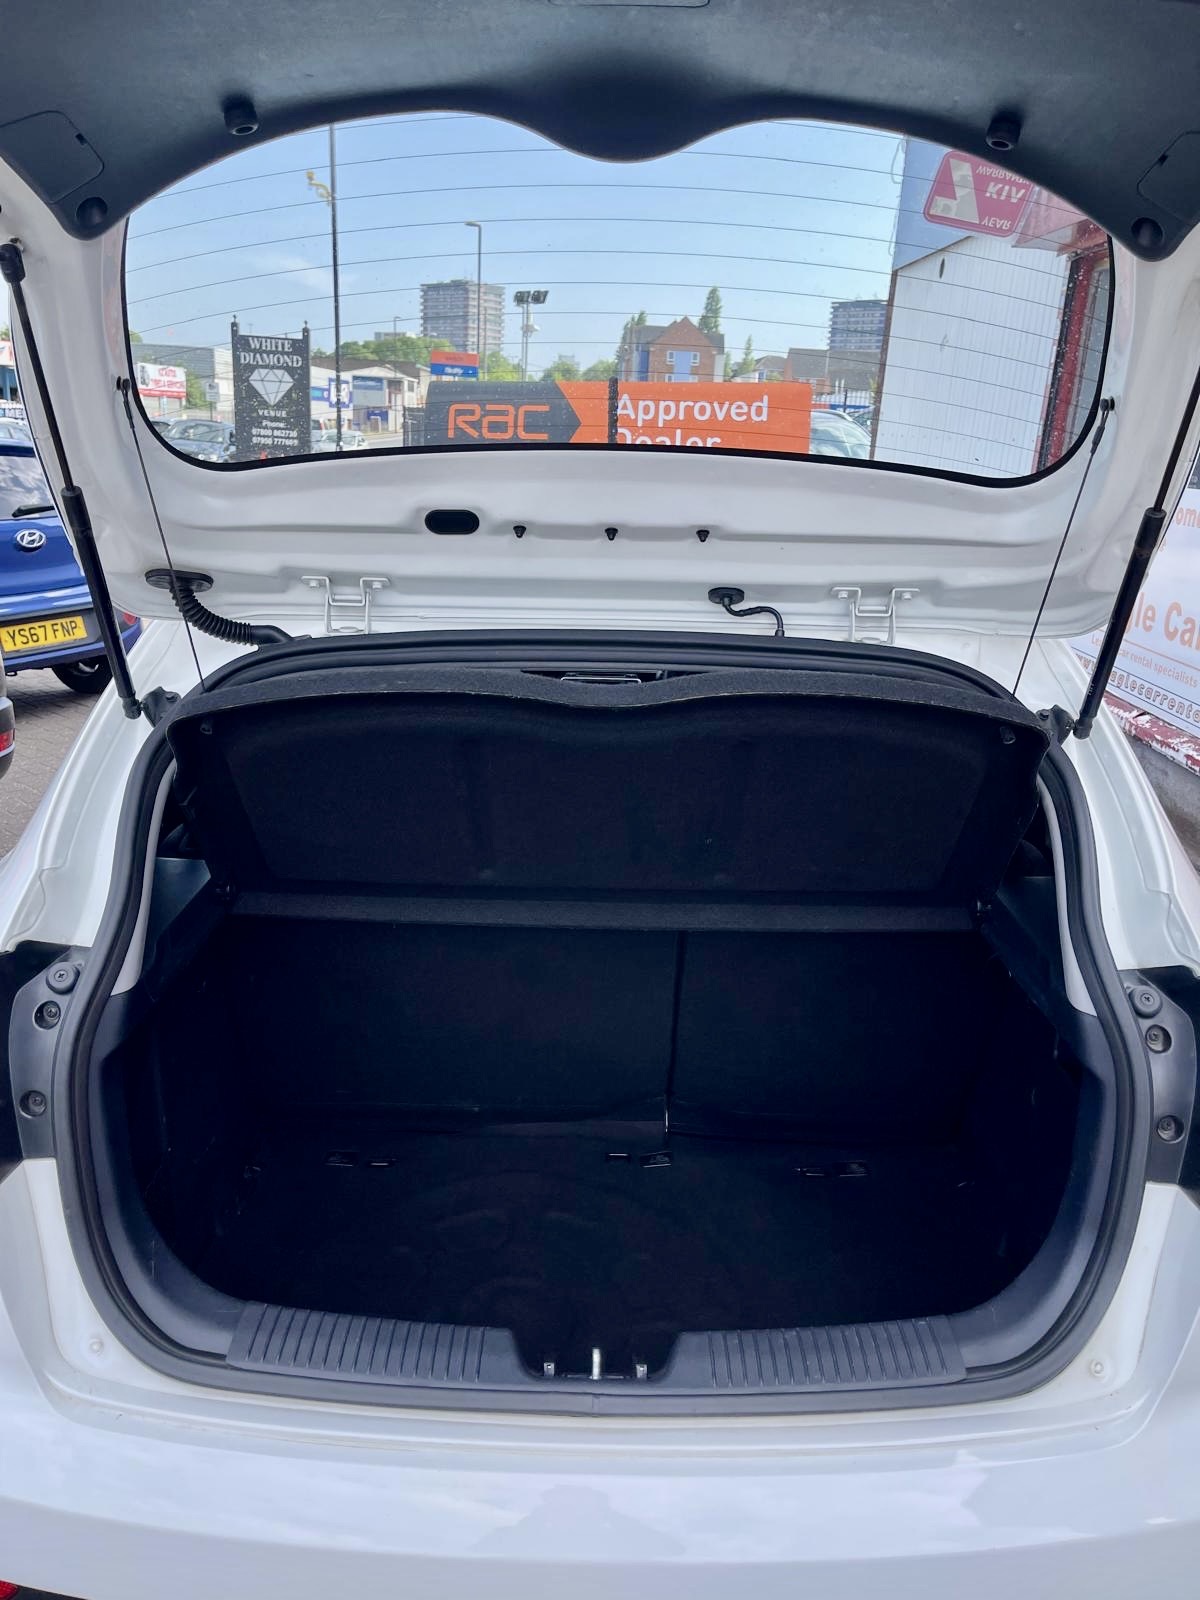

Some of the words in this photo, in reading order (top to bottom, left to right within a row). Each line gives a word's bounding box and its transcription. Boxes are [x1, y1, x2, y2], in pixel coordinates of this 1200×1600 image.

[249, 337, 292, 351] WHITE
[240, 352, 302, 367] DIAMOND
[258, 409, 287, 417] VENUE
[617, 393, 769, 427] Approved
[6, 625, 48, 647] YS67
[51, 620, 78, 639] FNP
[1154, 662, 1198, 688] specialists
